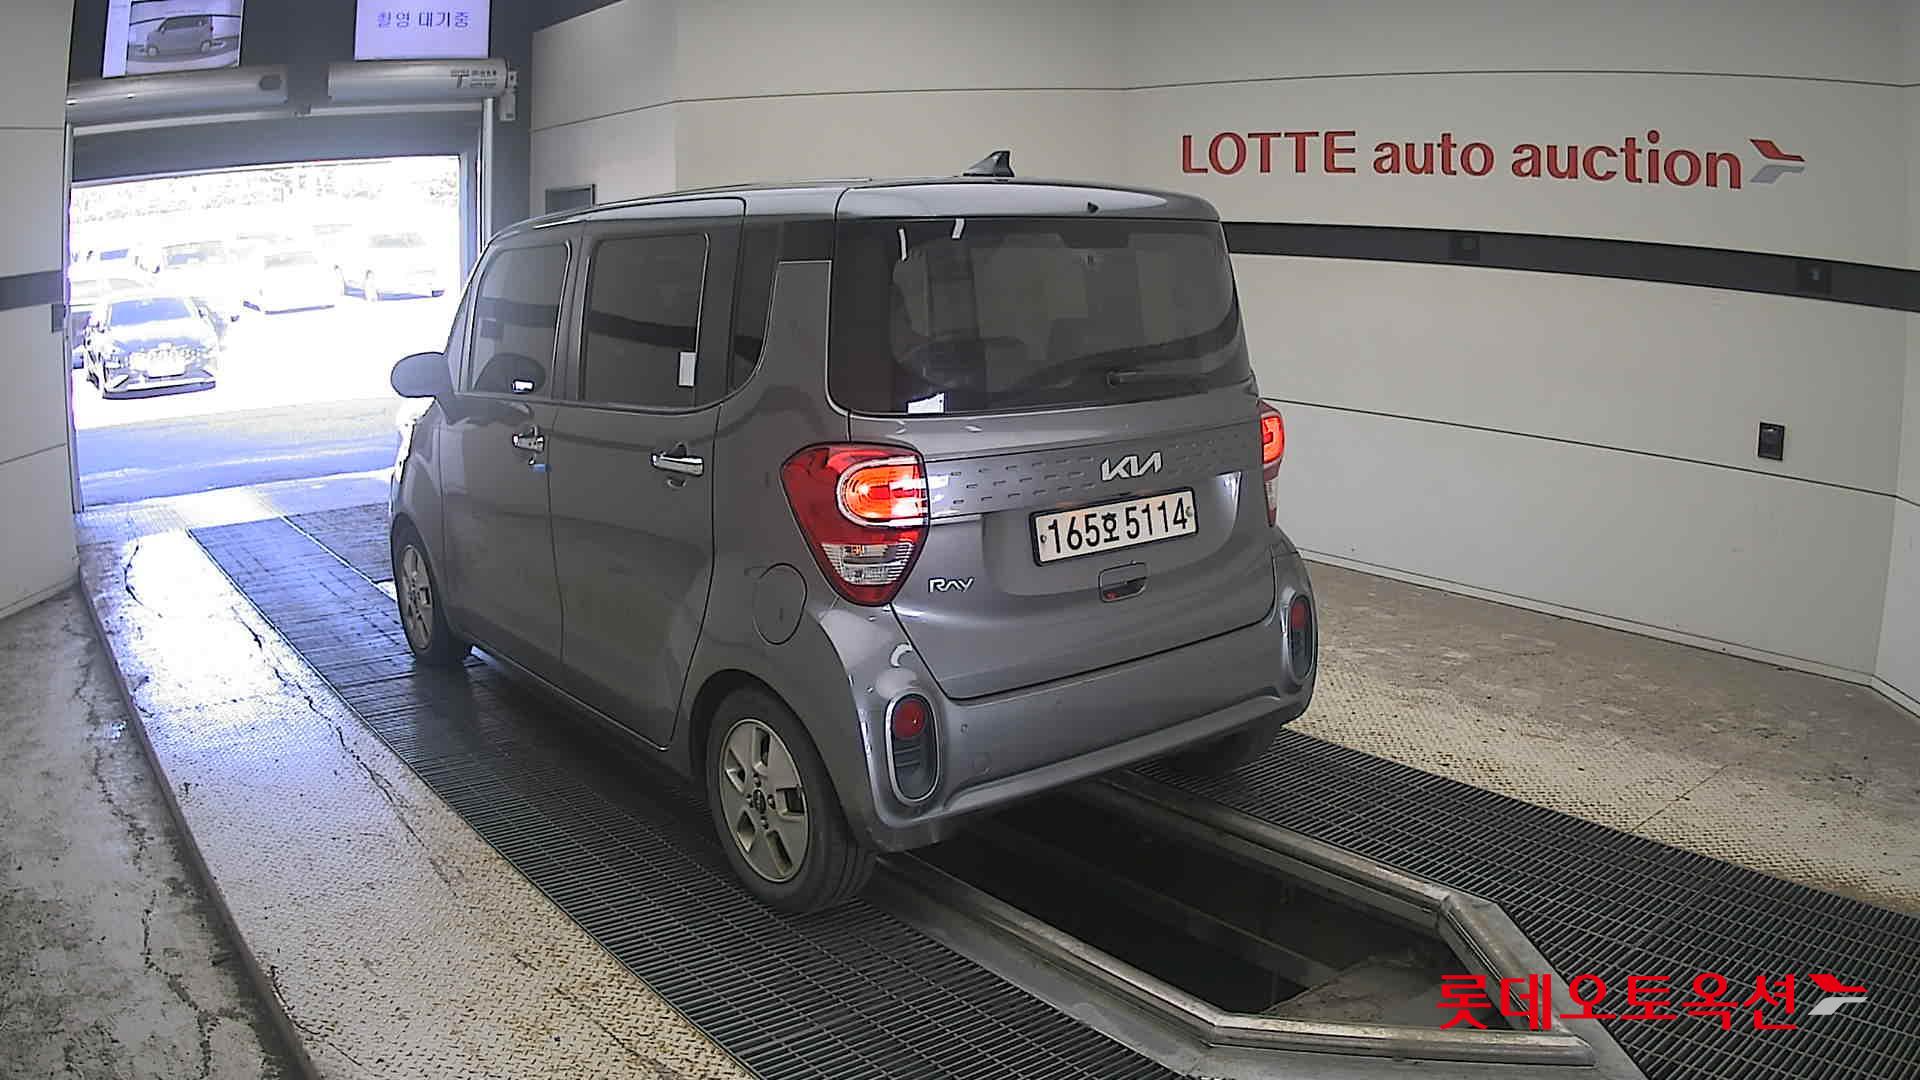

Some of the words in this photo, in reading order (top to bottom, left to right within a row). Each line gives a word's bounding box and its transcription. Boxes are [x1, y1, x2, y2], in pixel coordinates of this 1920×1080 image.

[418, 10, 469, 28] 대기중
[1181, 130, 1357, 175] LOTTE
[1372, 132, 1495, 177] auto
[1511, 129, 1743, 190] auction
[928, 577, 974, 593] RAY
